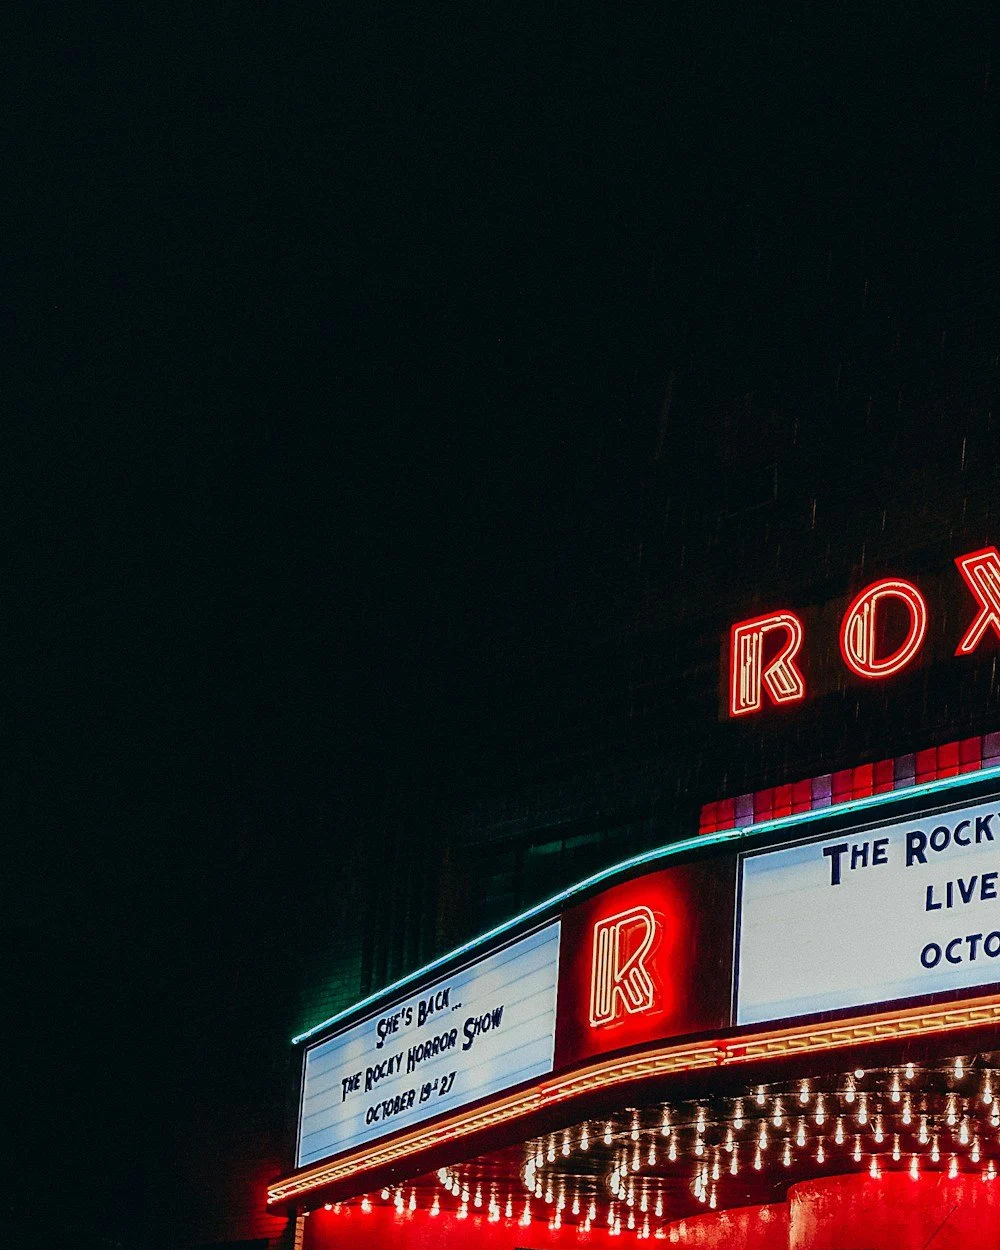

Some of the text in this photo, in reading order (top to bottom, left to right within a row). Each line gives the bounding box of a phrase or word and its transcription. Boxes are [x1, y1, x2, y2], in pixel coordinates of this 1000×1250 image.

[823, 838, 889, 885] THE
[925, 872, 998, 911] LIVE
[589, 905, 656, 1027] R
[376, 1007, 413, 1049] SHE'S
[342, 1005, 504, 1102] THE ROCKY HORROR SHOW
[365, 1089, 416, 1124] OCTOBER
